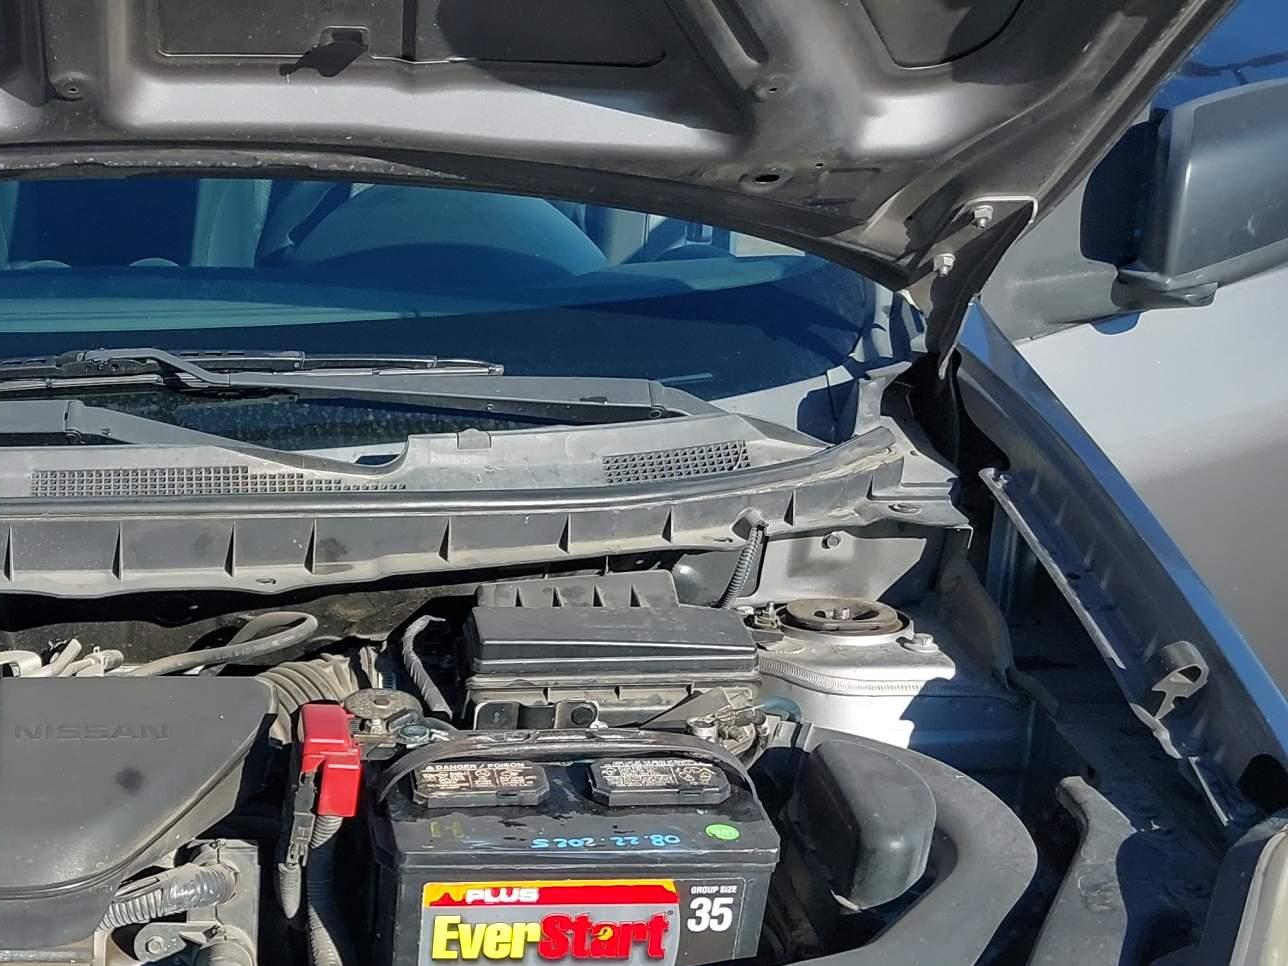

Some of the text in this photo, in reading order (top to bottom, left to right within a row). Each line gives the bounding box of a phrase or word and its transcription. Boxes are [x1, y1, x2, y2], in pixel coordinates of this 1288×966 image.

[13, 724, 168, 740] NISSAN
[465, 887, 539, 904] PLUS
[691, 885, 737, 894] GROUP SIZE
[687, 896, 734, 932] 35
[431, 911, 669, 961] EverStart
